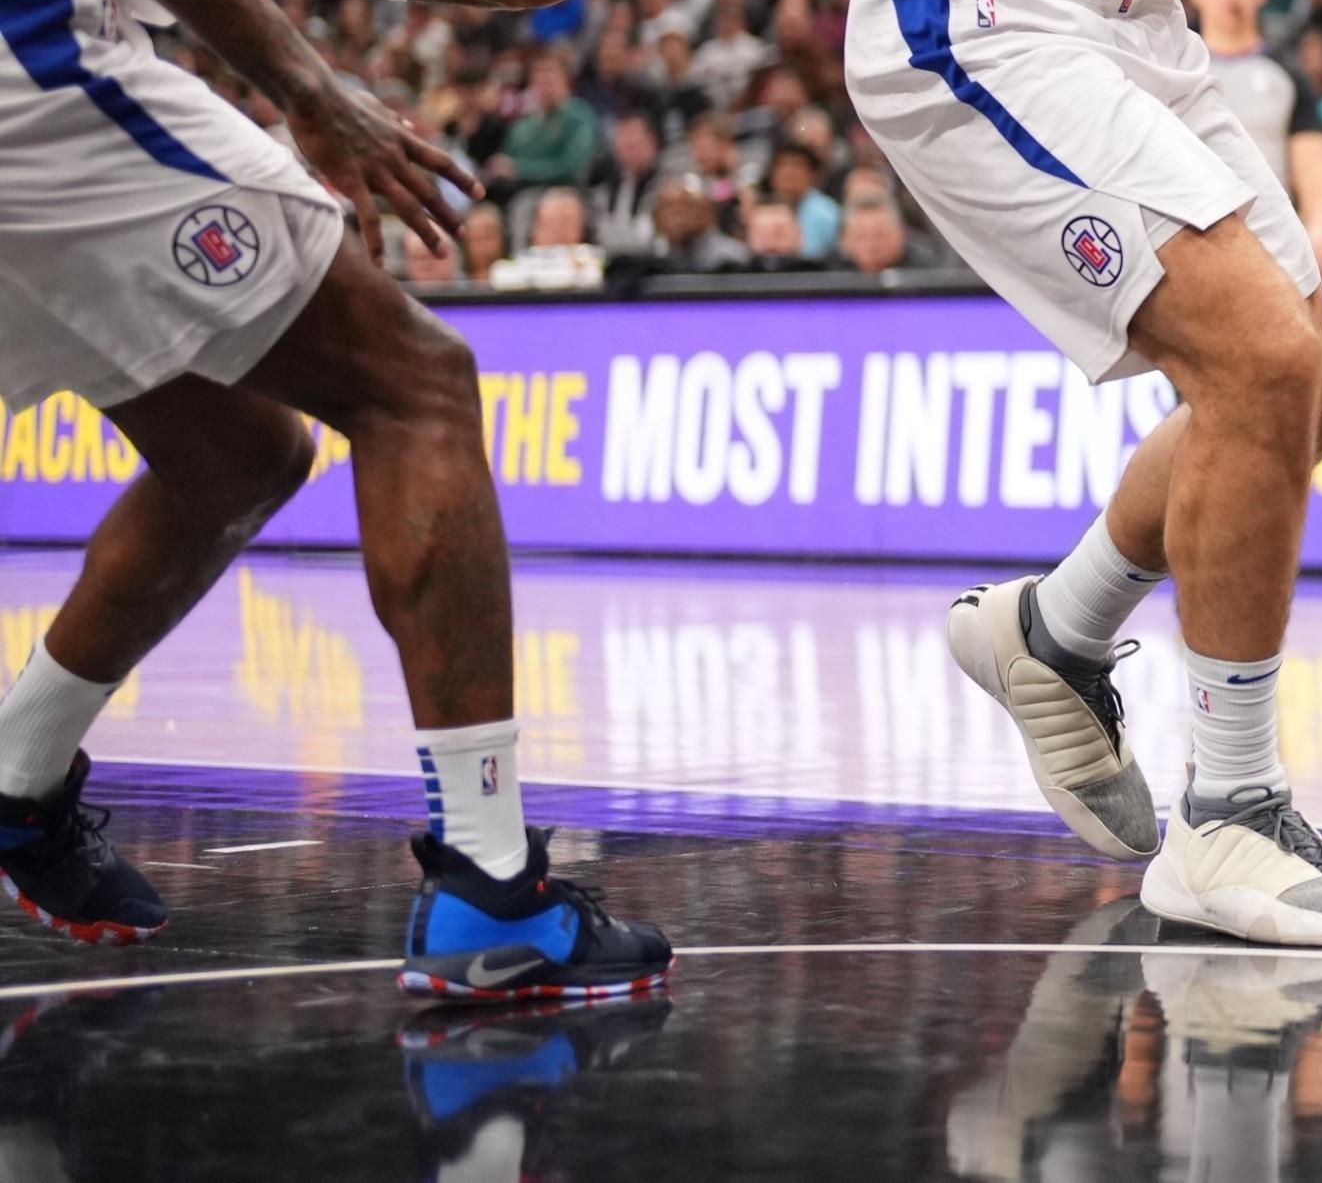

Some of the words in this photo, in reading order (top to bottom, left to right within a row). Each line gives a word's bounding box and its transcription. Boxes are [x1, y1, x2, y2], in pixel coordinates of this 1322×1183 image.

[478, 370, 588, 486] THE
[601, 350, 842, 507] MOST
[853, 350, 1178, 510] INTENS
